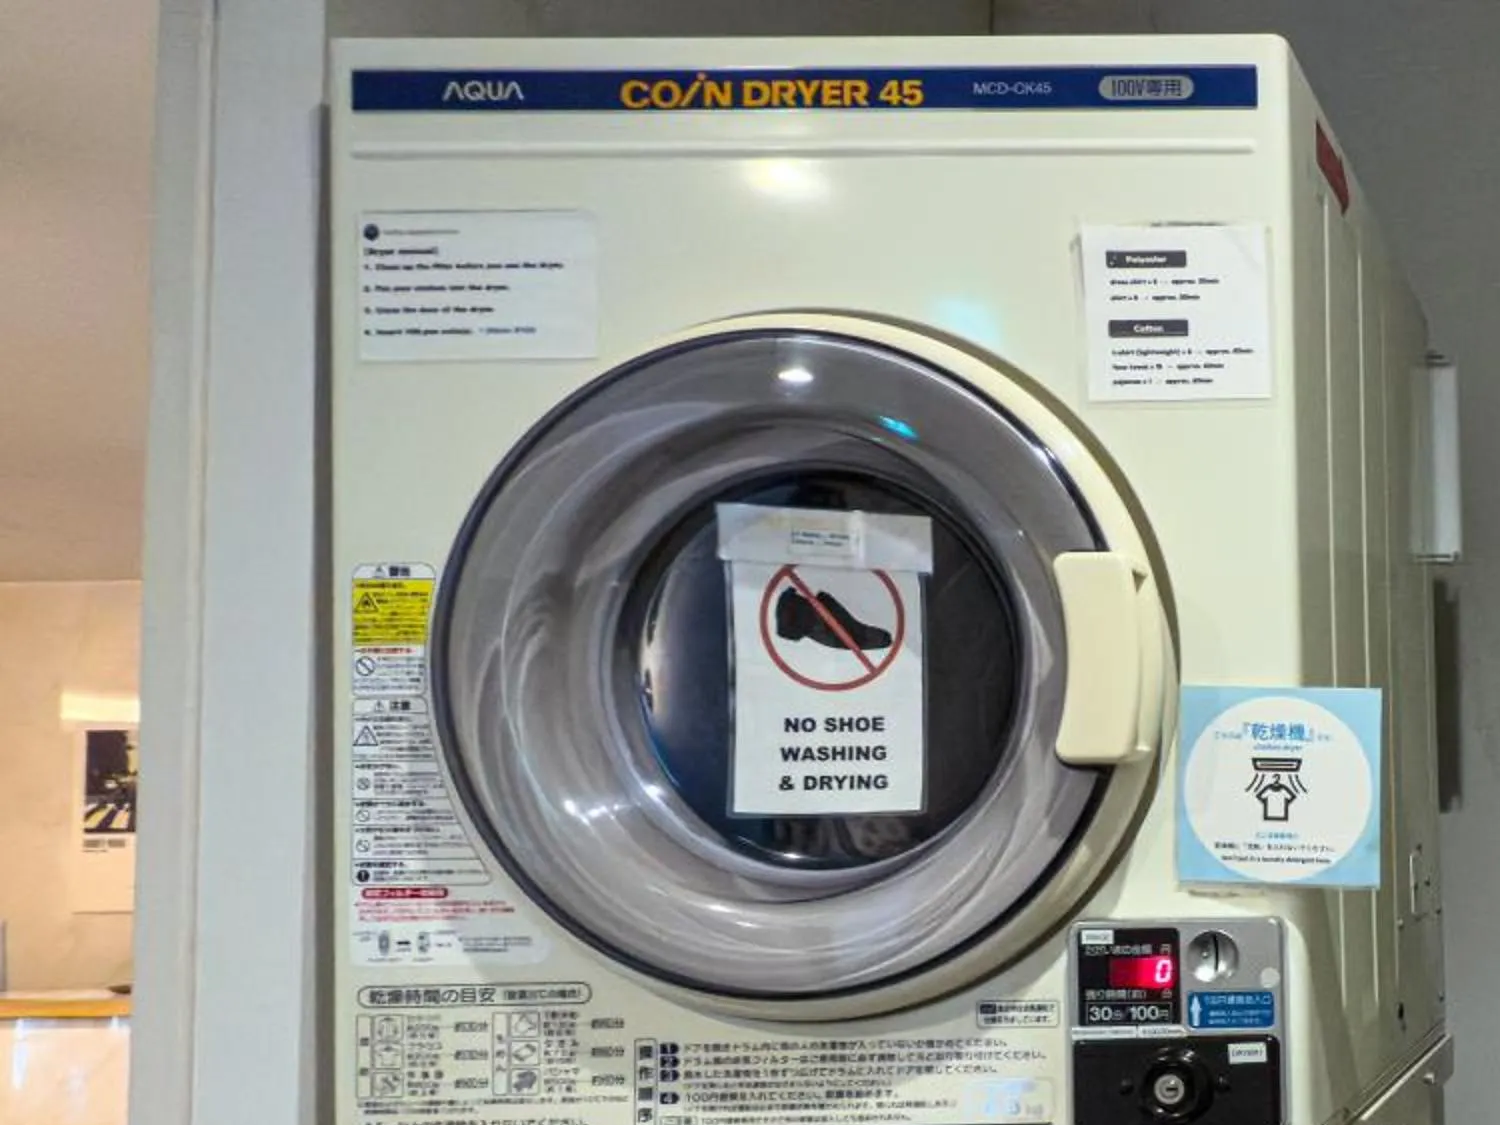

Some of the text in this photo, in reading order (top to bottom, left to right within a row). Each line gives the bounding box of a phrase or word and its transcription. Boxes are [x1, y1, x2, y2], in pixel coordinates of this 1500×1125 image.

[444, 81, 524, 101] AQUA
[743, 79, 869, 107] DRYER
[878, 79, 925, 106] 45
[784, 717, 884, 733] NO SHOE
[781, 746, 886, 761] WASHING
[779, 774, 888, 791] & DRYING
[1155, 959, 1173, 984] 0
[369, 987, 497, 1004] 乾燥時間の目安
